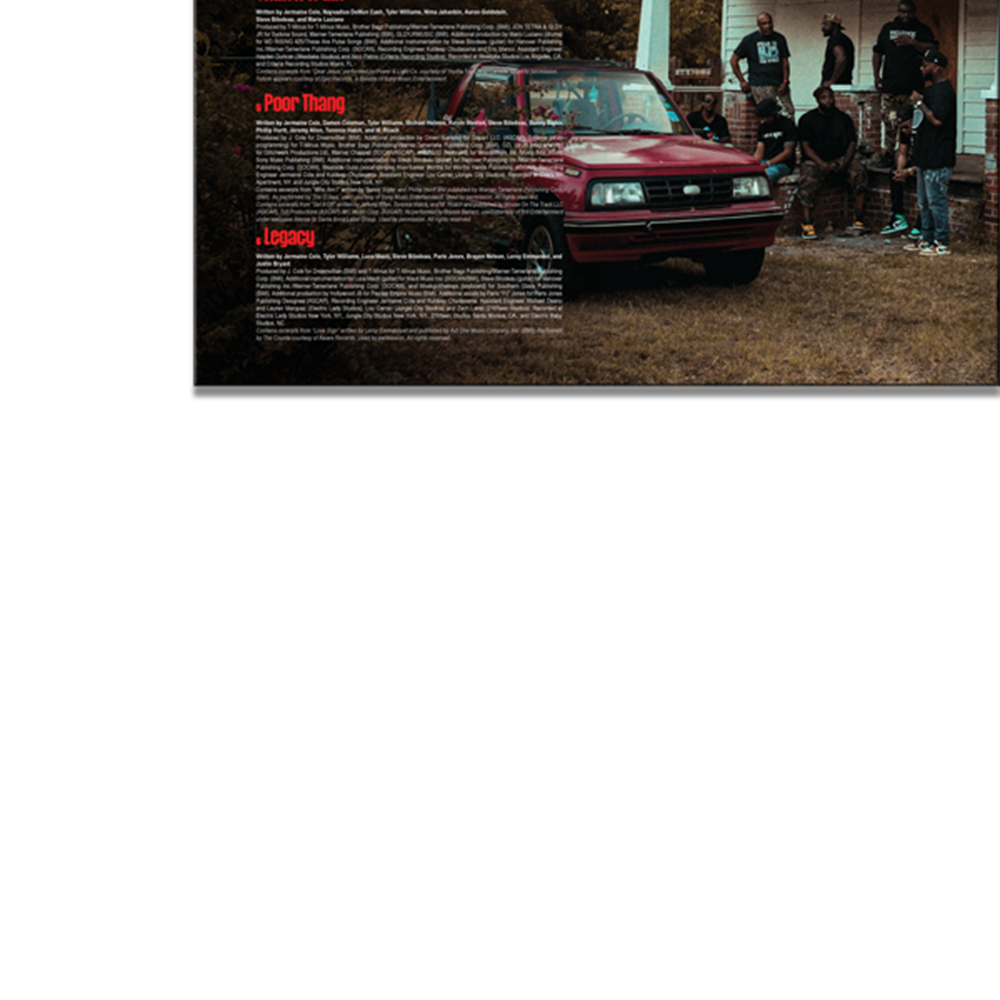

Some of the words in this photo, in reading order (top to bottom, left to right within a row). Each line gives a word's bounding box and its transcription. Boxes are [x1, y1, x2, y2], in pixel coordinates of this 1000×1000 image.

[264, 92, 300, 112] Poor
[302, 92, 346, 114] Thang
[264, 226, 314, 248] Legacy
